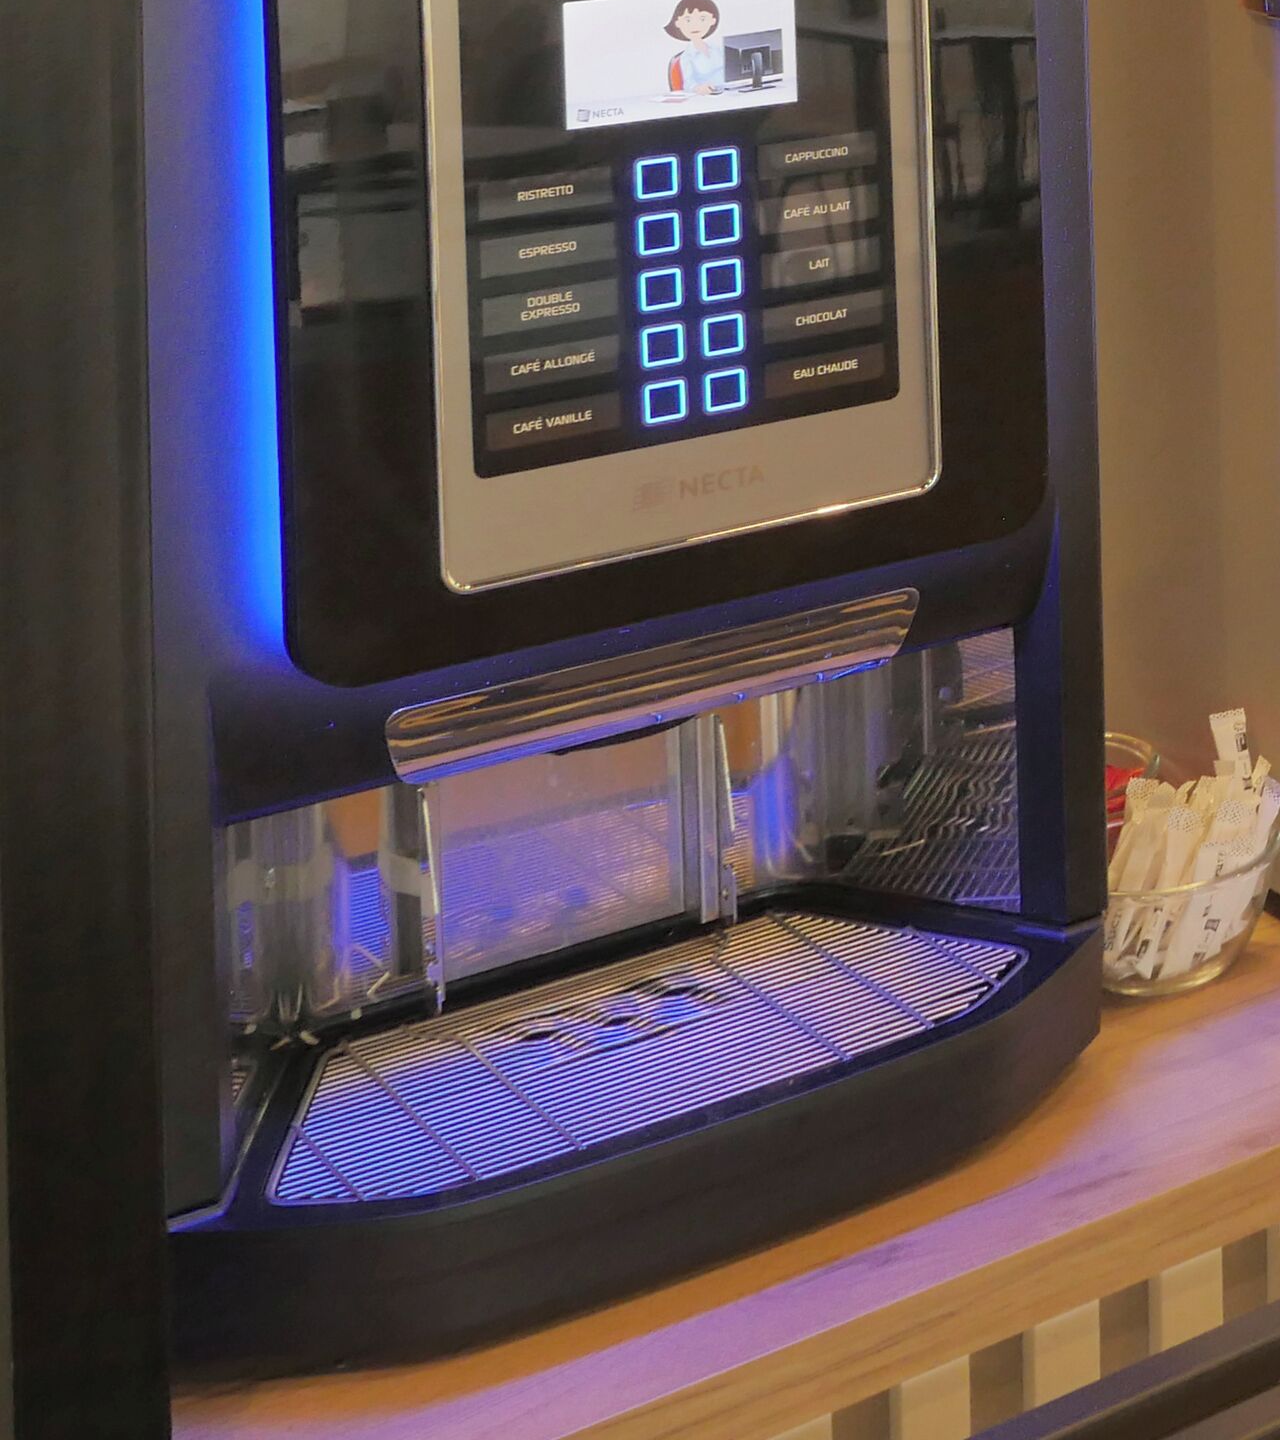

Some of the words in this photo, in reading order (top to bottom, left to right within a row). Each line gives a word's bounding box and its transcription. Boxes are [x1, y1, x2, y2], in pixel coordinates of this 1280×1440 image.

[592, 108, 624, 119] NECTA
[785, 146, 849, 163] CAPPUCCINO
[517, 184, 574, 202] RISTRETTO
[784, 204, 810, 220] CAFÉ
[813, 202, 828, 215] AU
[830, 200, 851, 212] LAIT
[518, 241, 577, 259] ESPRESSO
[809, 257, 830, 270] LAIT
[527, 291, 573, 308] DOUBLE
[521, 303, 580, 321] EXPRESSO
[796, 309, 848, 327] CHOCOLAT
[511, 359, 541, 376] CAFÉ
[544, 351, 596, 371] ALLONGÉ
[793, 365, 816, 380] EAU
[817, 359, 859, 376] CHAUDE
[513, 416, 543, 435] CAFÉ
[546, 410, 593, 428] VANILLE
[679, 465, 765, 498] NECTA
